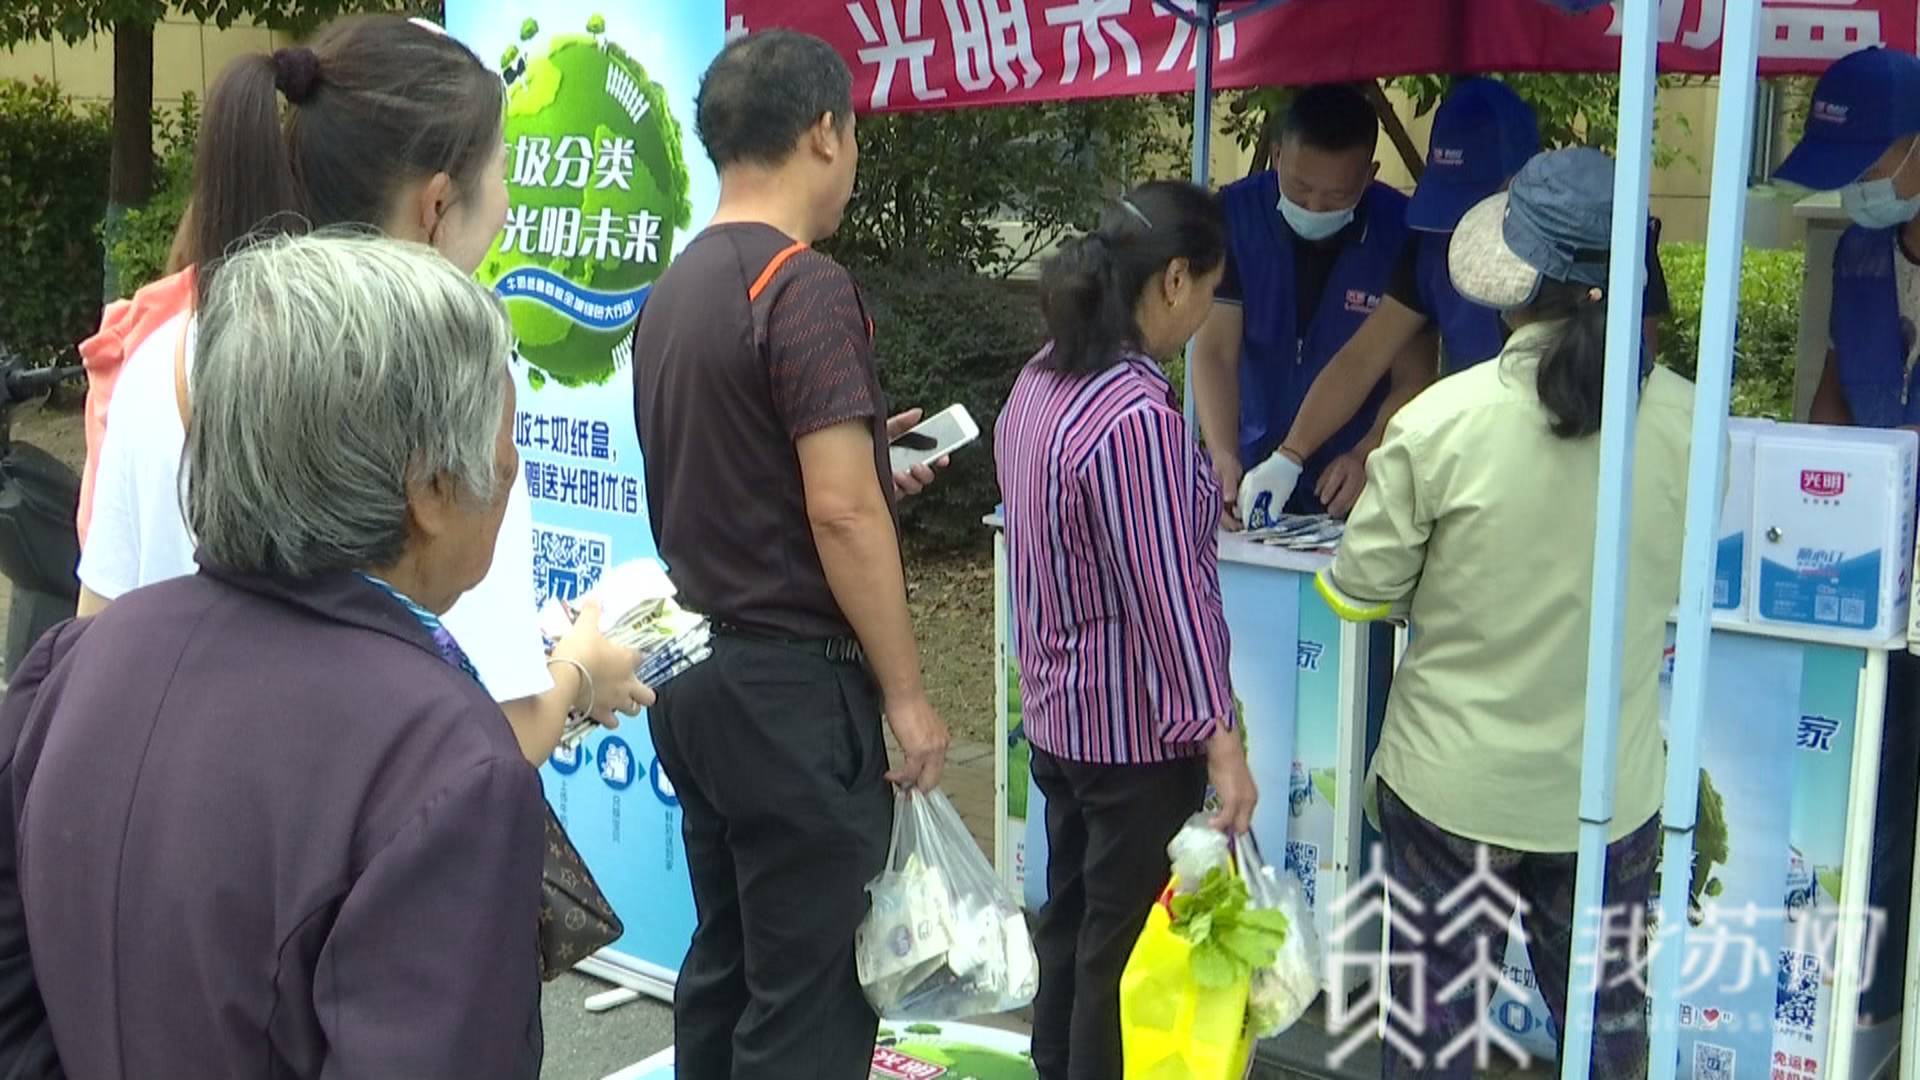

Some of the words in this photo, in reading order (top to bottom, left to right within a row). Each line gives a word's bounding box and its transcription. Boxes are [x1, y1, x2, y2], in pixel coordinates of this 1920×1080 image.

[504, 135, 636, 190] 圾分类
[501, 205, 663, 263] 光明未来
[1803, 472, 1841, 490] 光明
[1297, 640, 1323, 670] 家
[1797, 715, 1839, 751] 家
[873, 1049, 938, 1080] 光明
[1774, 1050, 1817, 1073] 免运费
